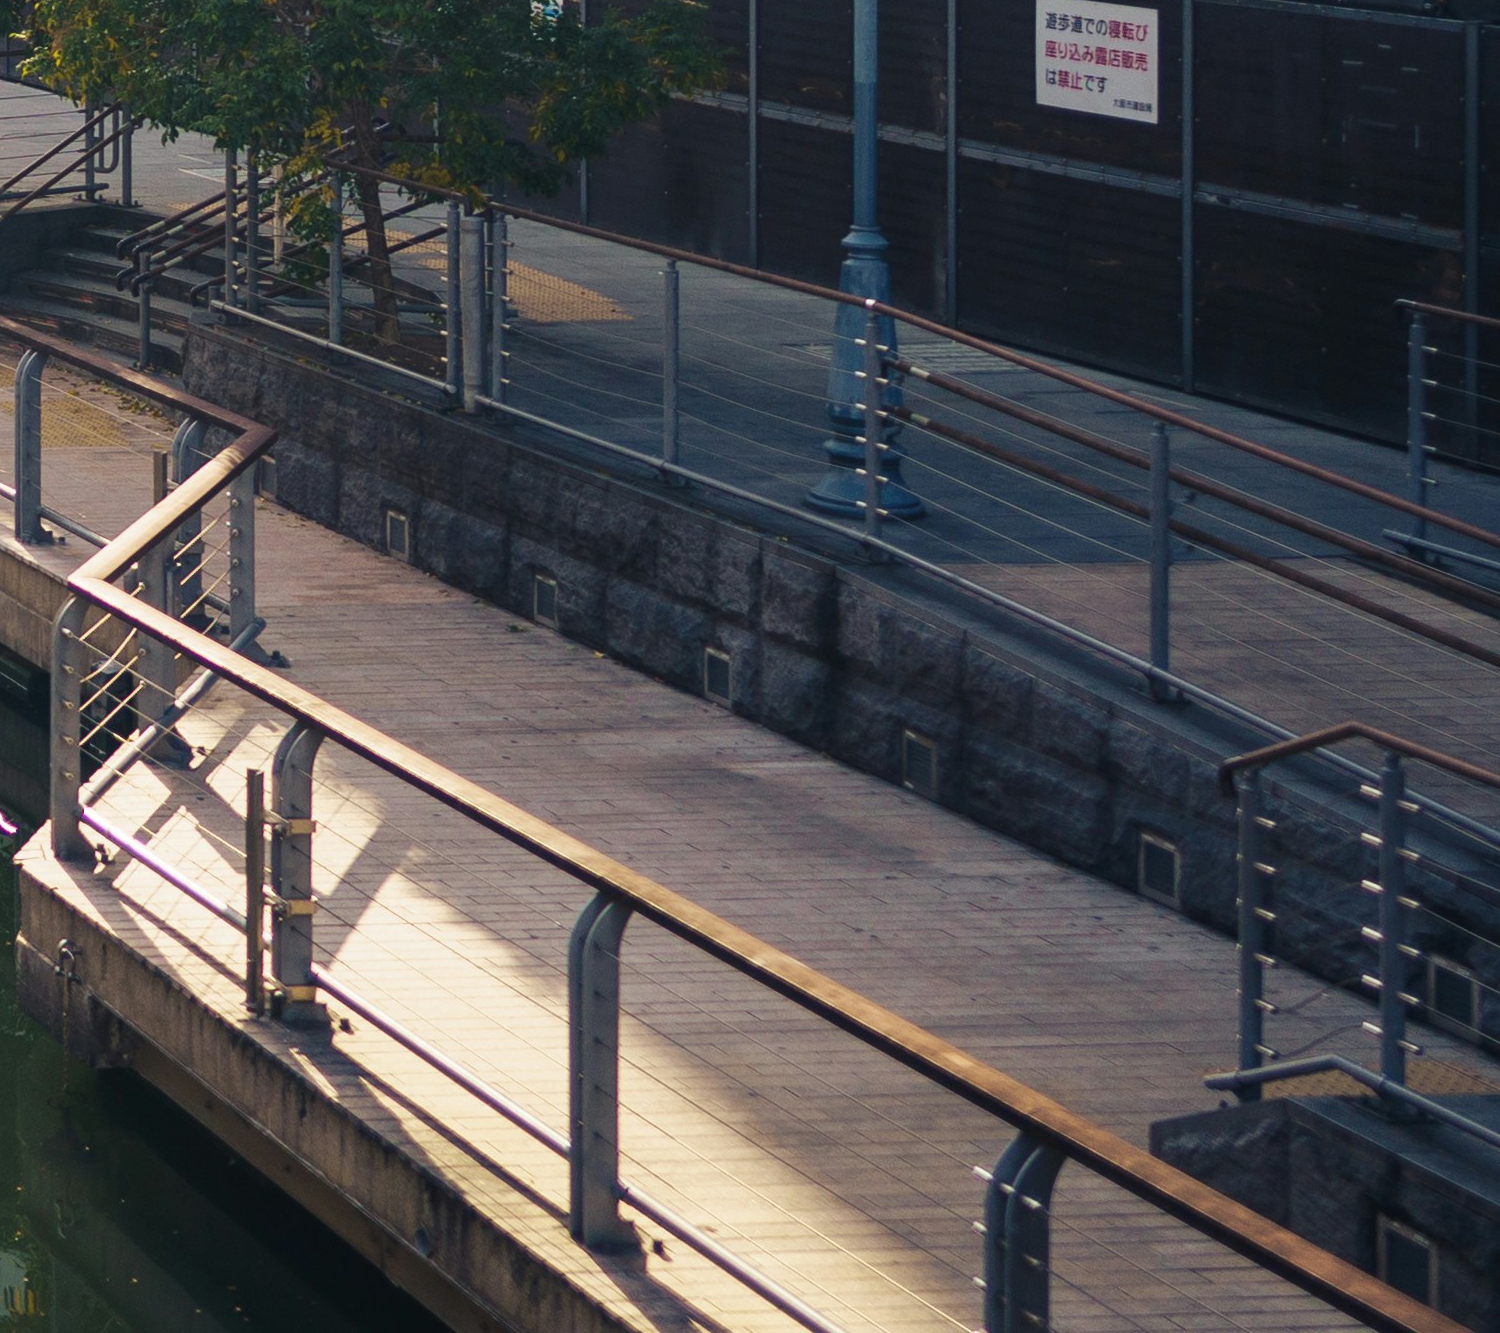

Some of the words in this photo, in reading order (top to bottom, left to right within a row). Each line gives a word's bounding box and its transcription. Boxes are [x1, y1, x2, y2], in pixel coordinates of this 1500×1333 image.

[1045, 12, 1148, 42] 遊歩道での寝転び
[1045, 40, 1148, 71] 座り込み露店販売
[1046, 69, 1108, 93] は禁止です
